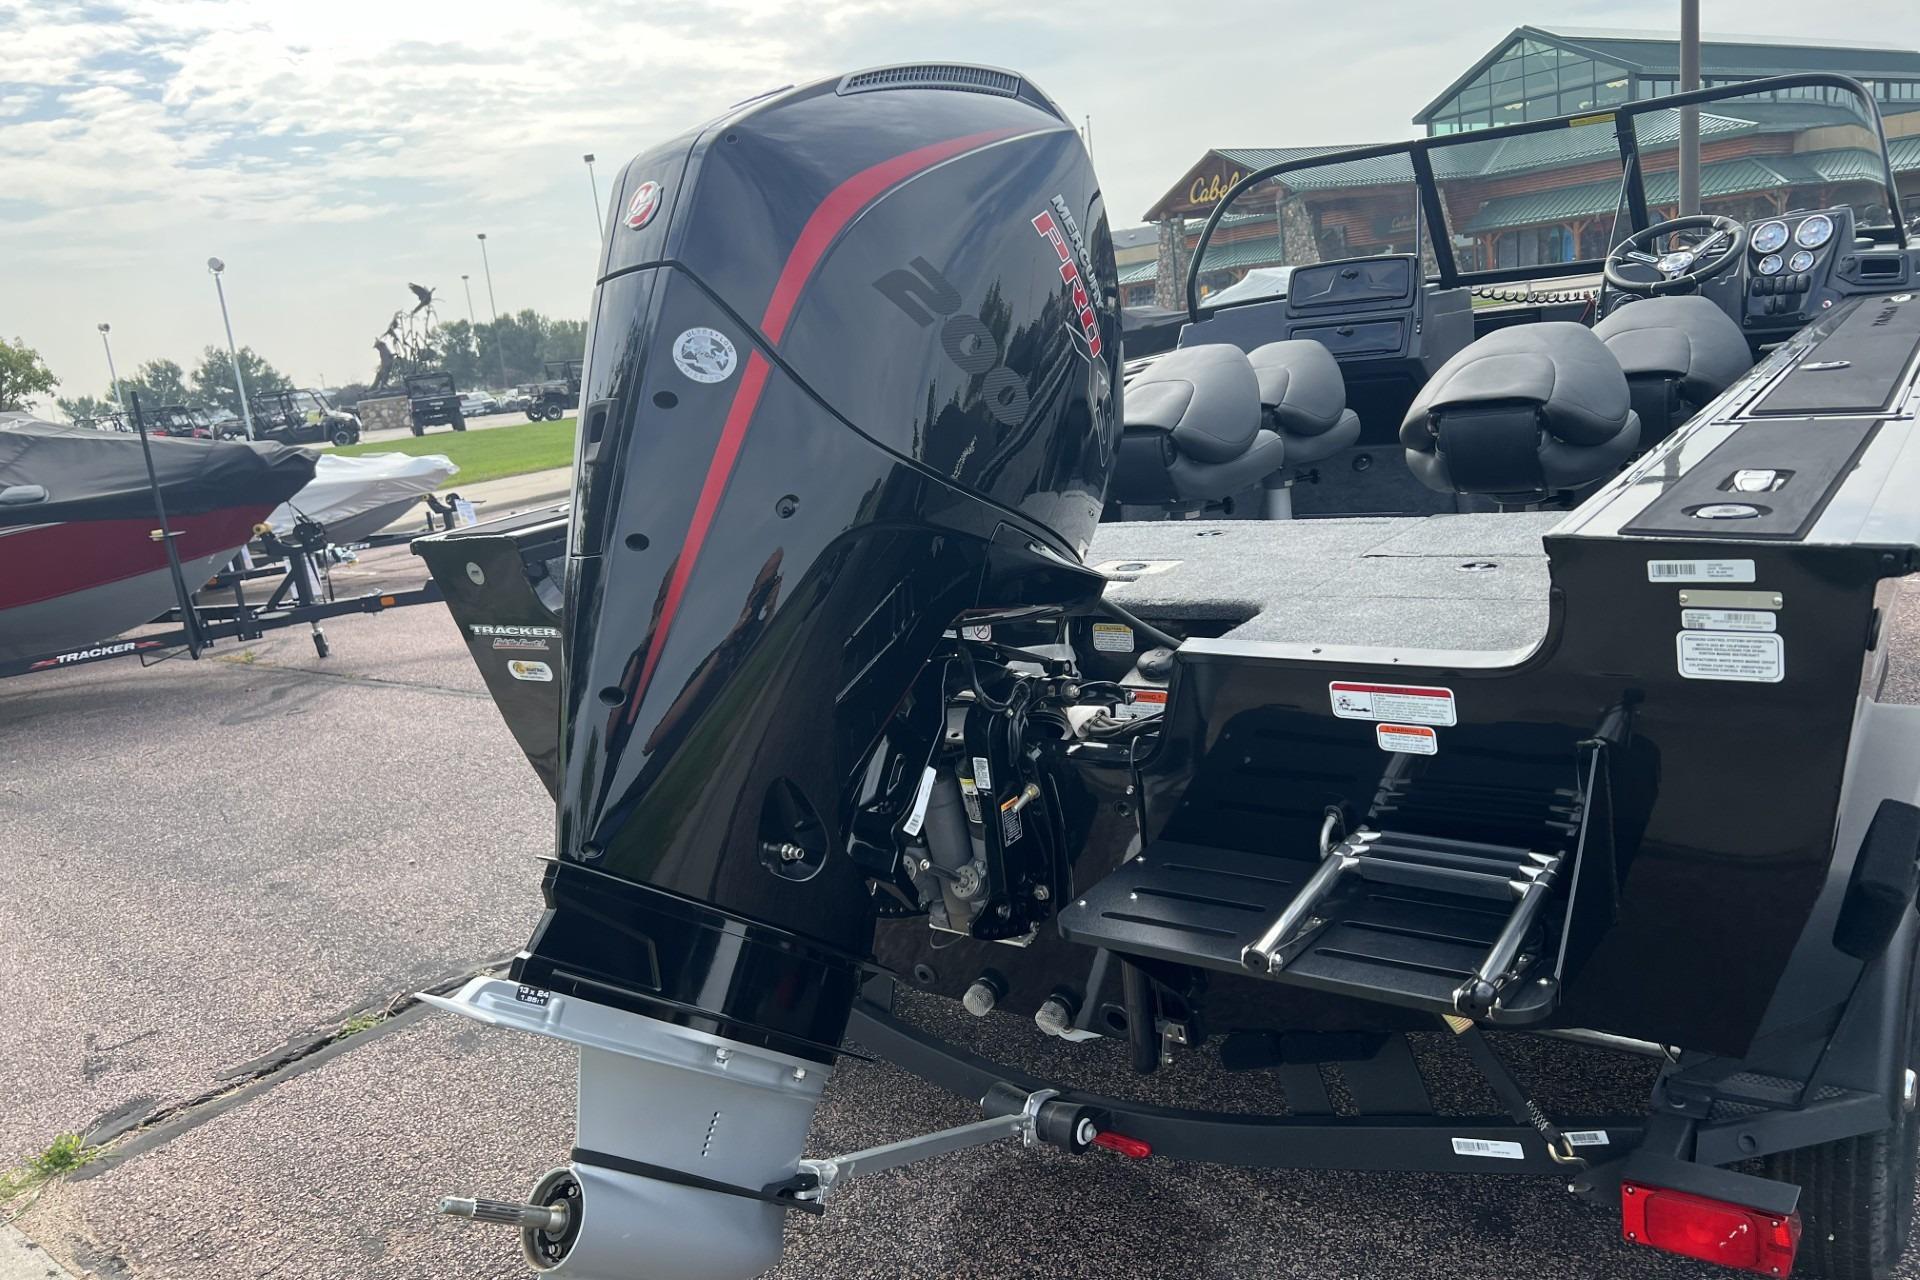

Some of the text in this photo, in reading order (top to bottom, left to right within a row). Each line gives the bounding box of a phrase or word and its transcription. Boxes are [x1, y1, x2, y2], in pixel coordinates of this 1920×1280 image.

[1031, 209, 1101, 358] PRO
[1050, 194, 1104, 309] MERCURY
[872, 255, 1031, 426] 200
[56, 641, 136, 664] TRACKER
[472, 625, 557, 636] TRACKER
[520, 986, 529, 994] 13
[537, 990, 549, 998] 24
